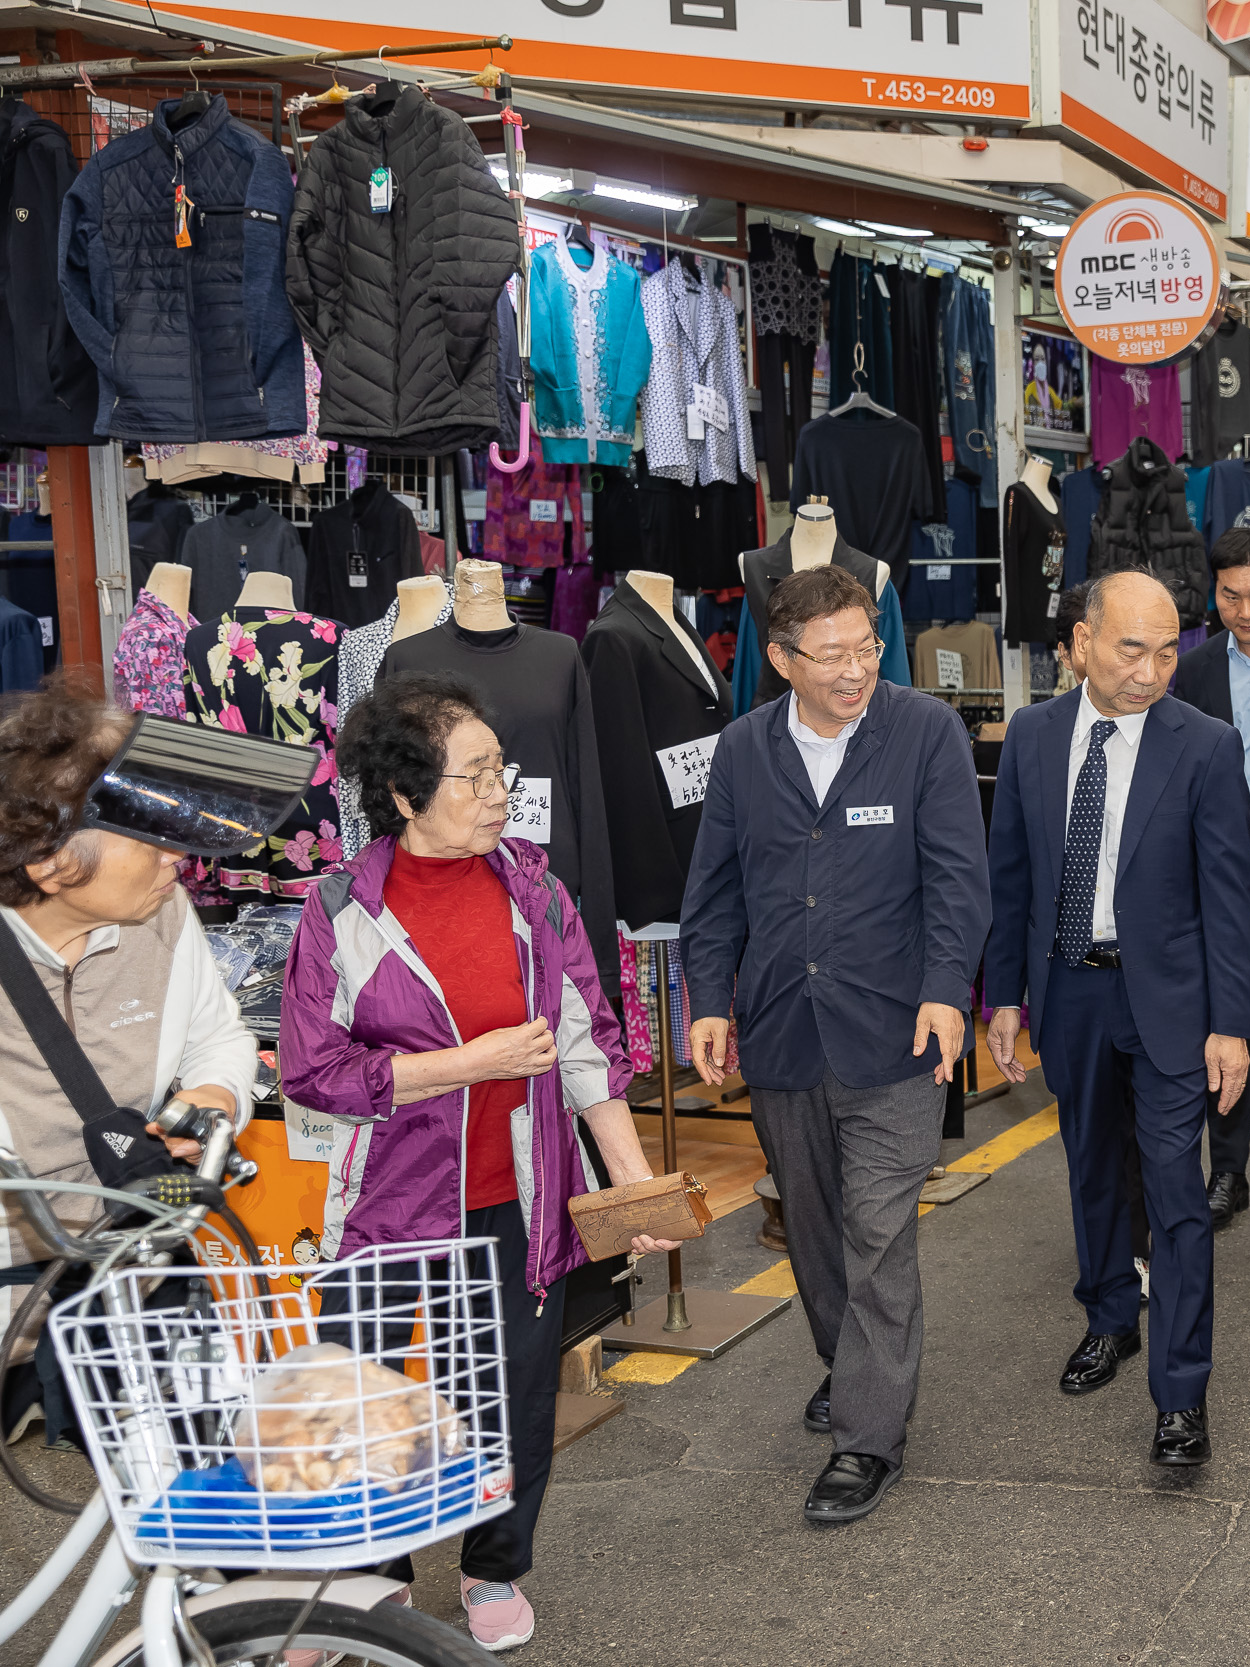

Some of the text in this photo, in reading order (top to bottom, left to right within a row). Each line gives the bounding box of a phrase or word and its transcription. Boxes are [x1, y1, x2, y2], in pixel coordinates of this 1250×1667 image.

[1077, 0, 1216, 145] 현대종합의류
[861, 78, 996, 108] T.453-2409
[1140, 246, 1191, 272] 생방송
[1073, 276, 1203, 310] 오늘저녁 방영
[1092, 322, 1187, 342] (각종 단체복 전문)
[1117, 341, 1166, 357] 옷의달인
[103, 1131, 127, 1160] adidas
